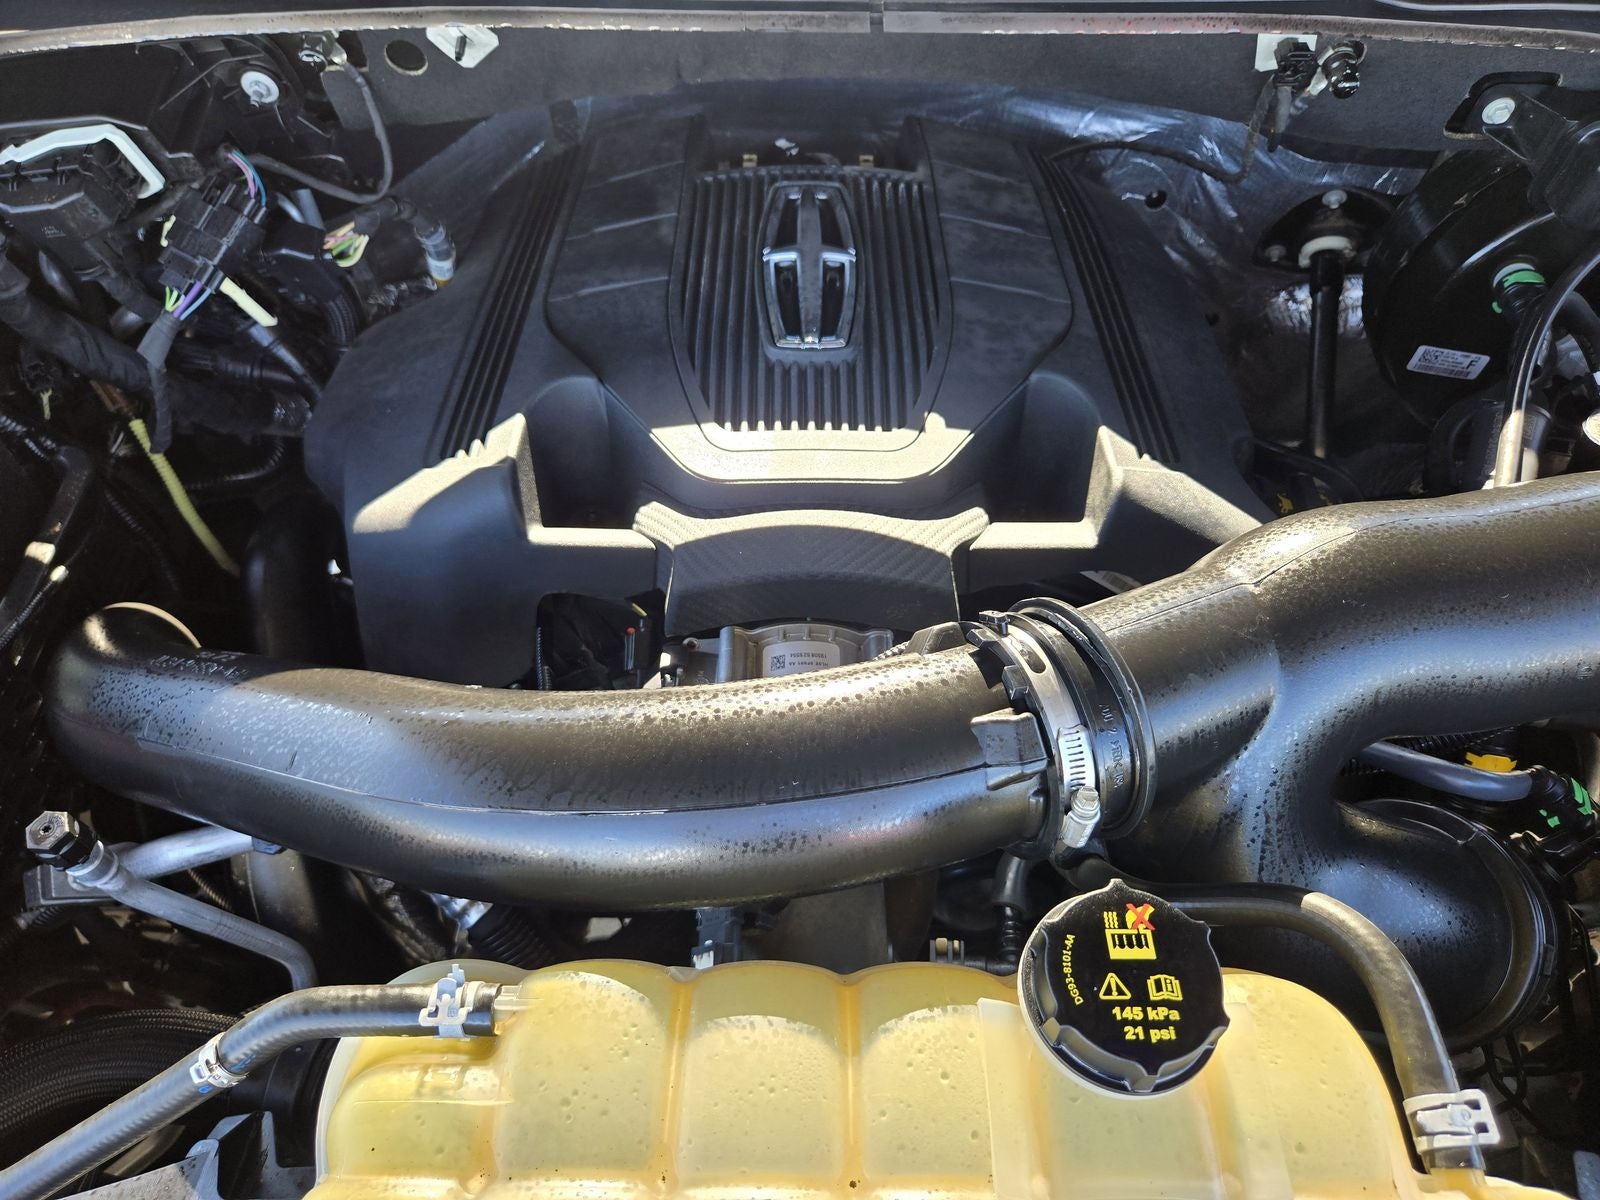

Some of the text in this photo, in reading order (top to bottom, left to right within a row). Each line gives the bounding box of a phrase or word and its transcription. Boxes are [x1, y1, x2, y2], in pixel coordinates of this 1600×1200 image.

[1466, 360, 1479, 370] F
[1062, 934, 1084, 1006] DG93-8101-AA
[1112, 1007, 1180, 1020] 145 kPa
[1124, 1026, 1176, 1043] 21 psi
